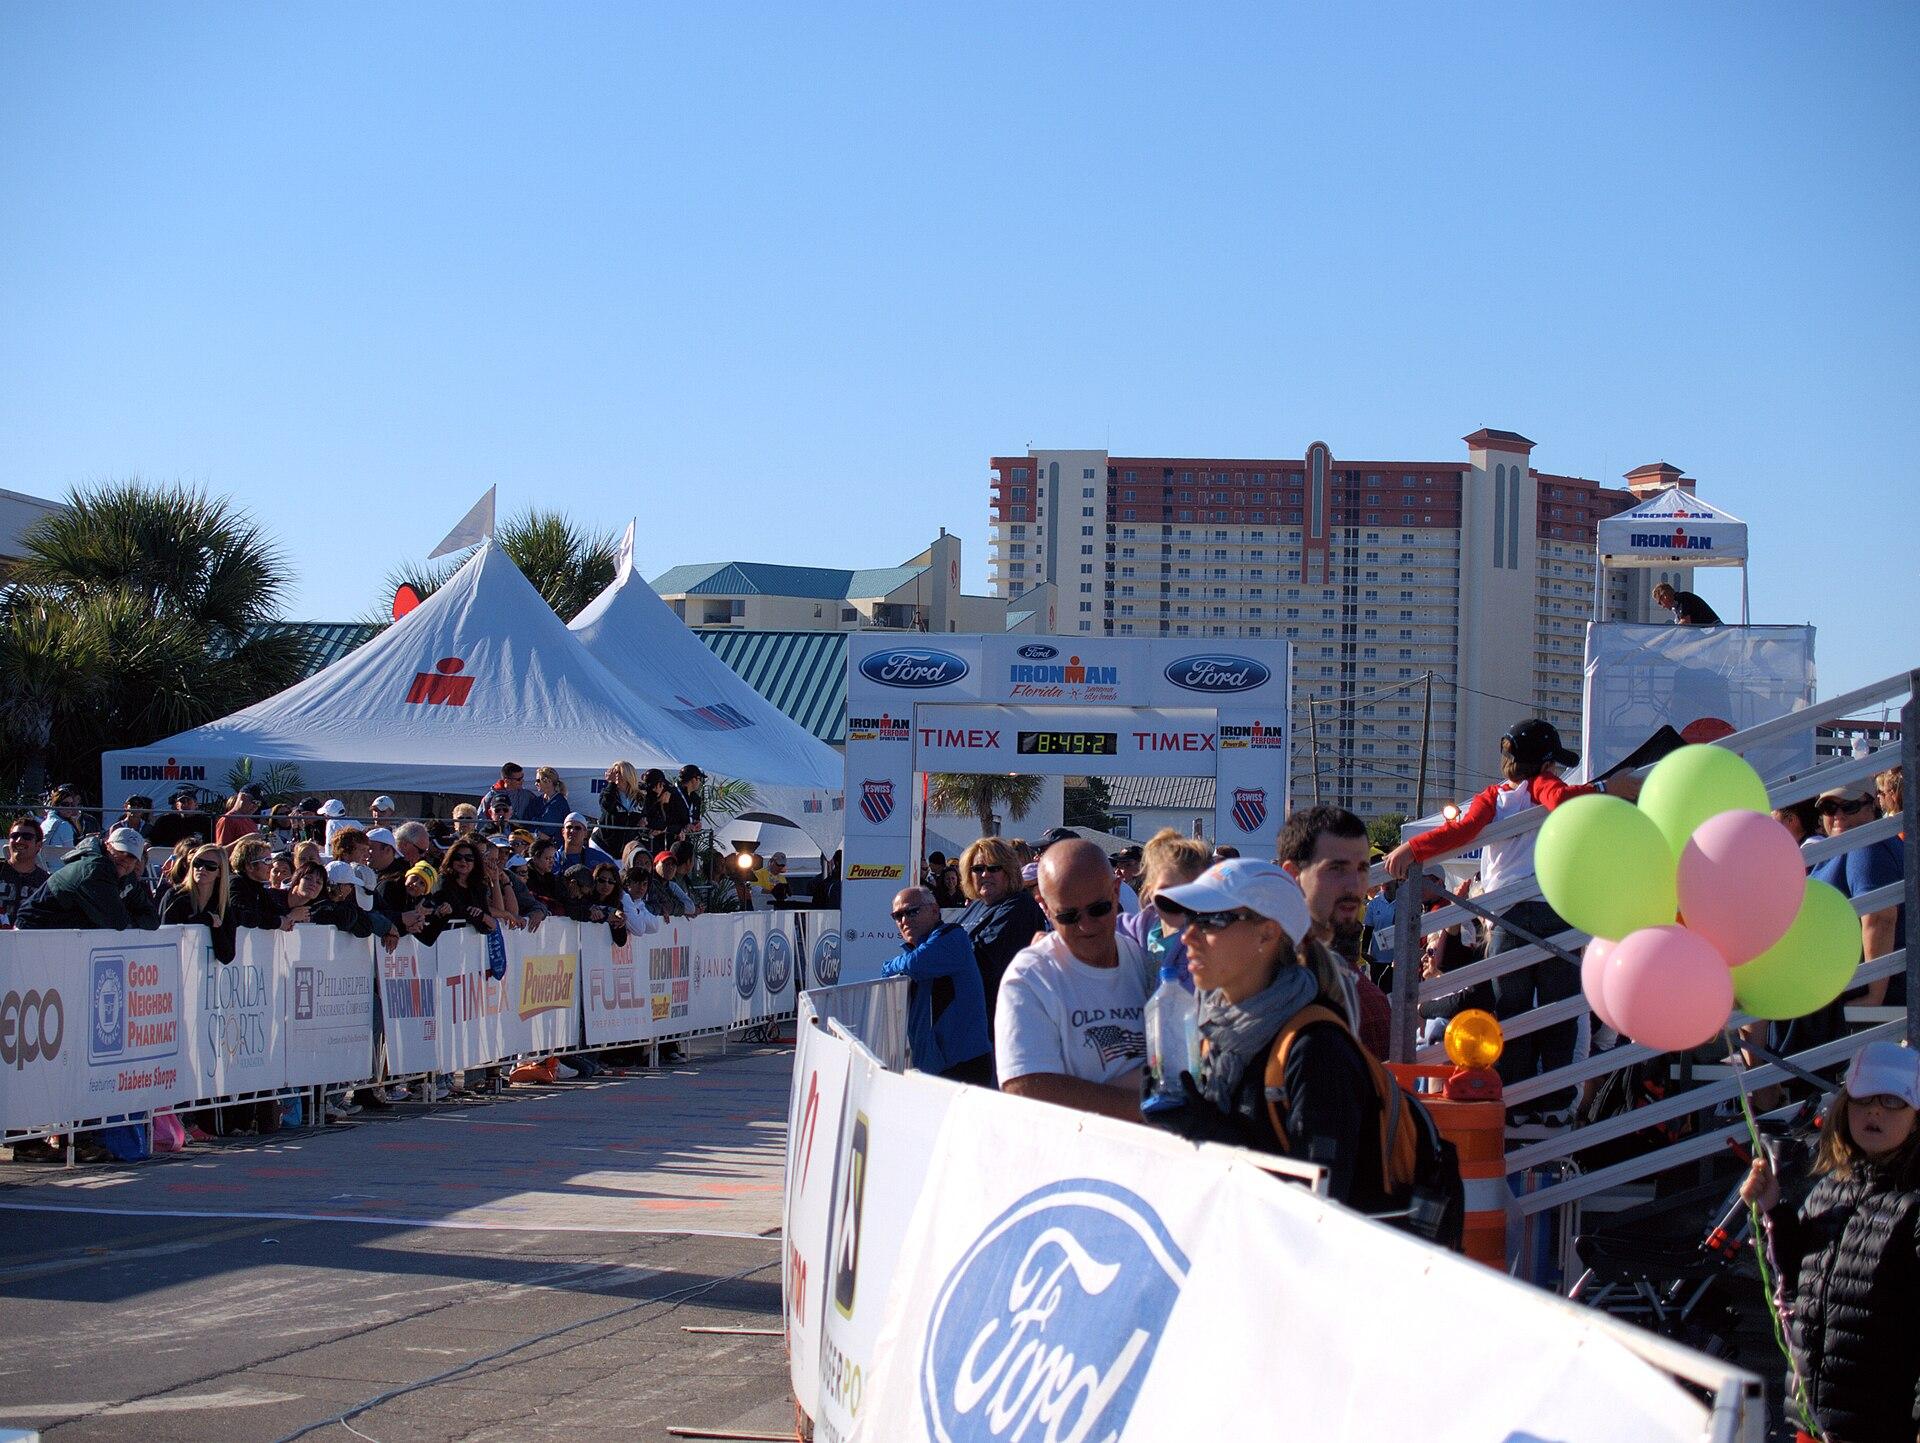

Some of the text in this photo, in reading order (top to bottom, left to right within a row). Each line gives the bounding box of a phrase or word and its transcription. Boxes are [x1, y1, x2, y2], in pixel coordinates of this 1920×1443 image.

[1630, 528, 1713, 550] IRONMAN
[1025, 646, 1051, 658] Ford
[881, 653, 947, 681] Ford
[1010, 656, 1118, 685] IRONMAN
[1185, 659, 1250, 686] Ford
[1009, 684, 1065, 698] Florida
[849, 714, 910, 729] IRONMAN
[1220, 720, 1282, 737] IRONMAN
[919, 729, 1000, 748] TIMEX
[1132, 732, 1216, 752] TIMEX
[120, 757, 206, 781] IRONMAN
[864, 784, 891, 794] K-SWISS
[1236, 793, 1263, 802] K-SWISS
[849, 865, 901, 878] PowerBar
[650, 930, 690, 980] IRONMAN
[702, 957, 733, 979] JANUS
[128, 961, 158, 988] GOOD
[205, 945, 268, 1011] FLORIDA
[316, 970, 370, 997] PHILADELPHIA
[523, 960, 574, 1006] PowerBar
[385, 978, 436, 1018] IRONMAN
[589, 968, 646, 1012] FUEL
[128, 991, 173, 1017] NEIGHBOR
[1071, 1009, 1105, 1028] OLD
[127, 1021, 177, 1048] PHARMACY
[207, 1011, 265, 1078] SPORTS
[118, 1070, 152, 1092] Diabetes
[153, 1065, 177, 1091] Shoppe
[953, 1227, 1150, 1443] Ford
